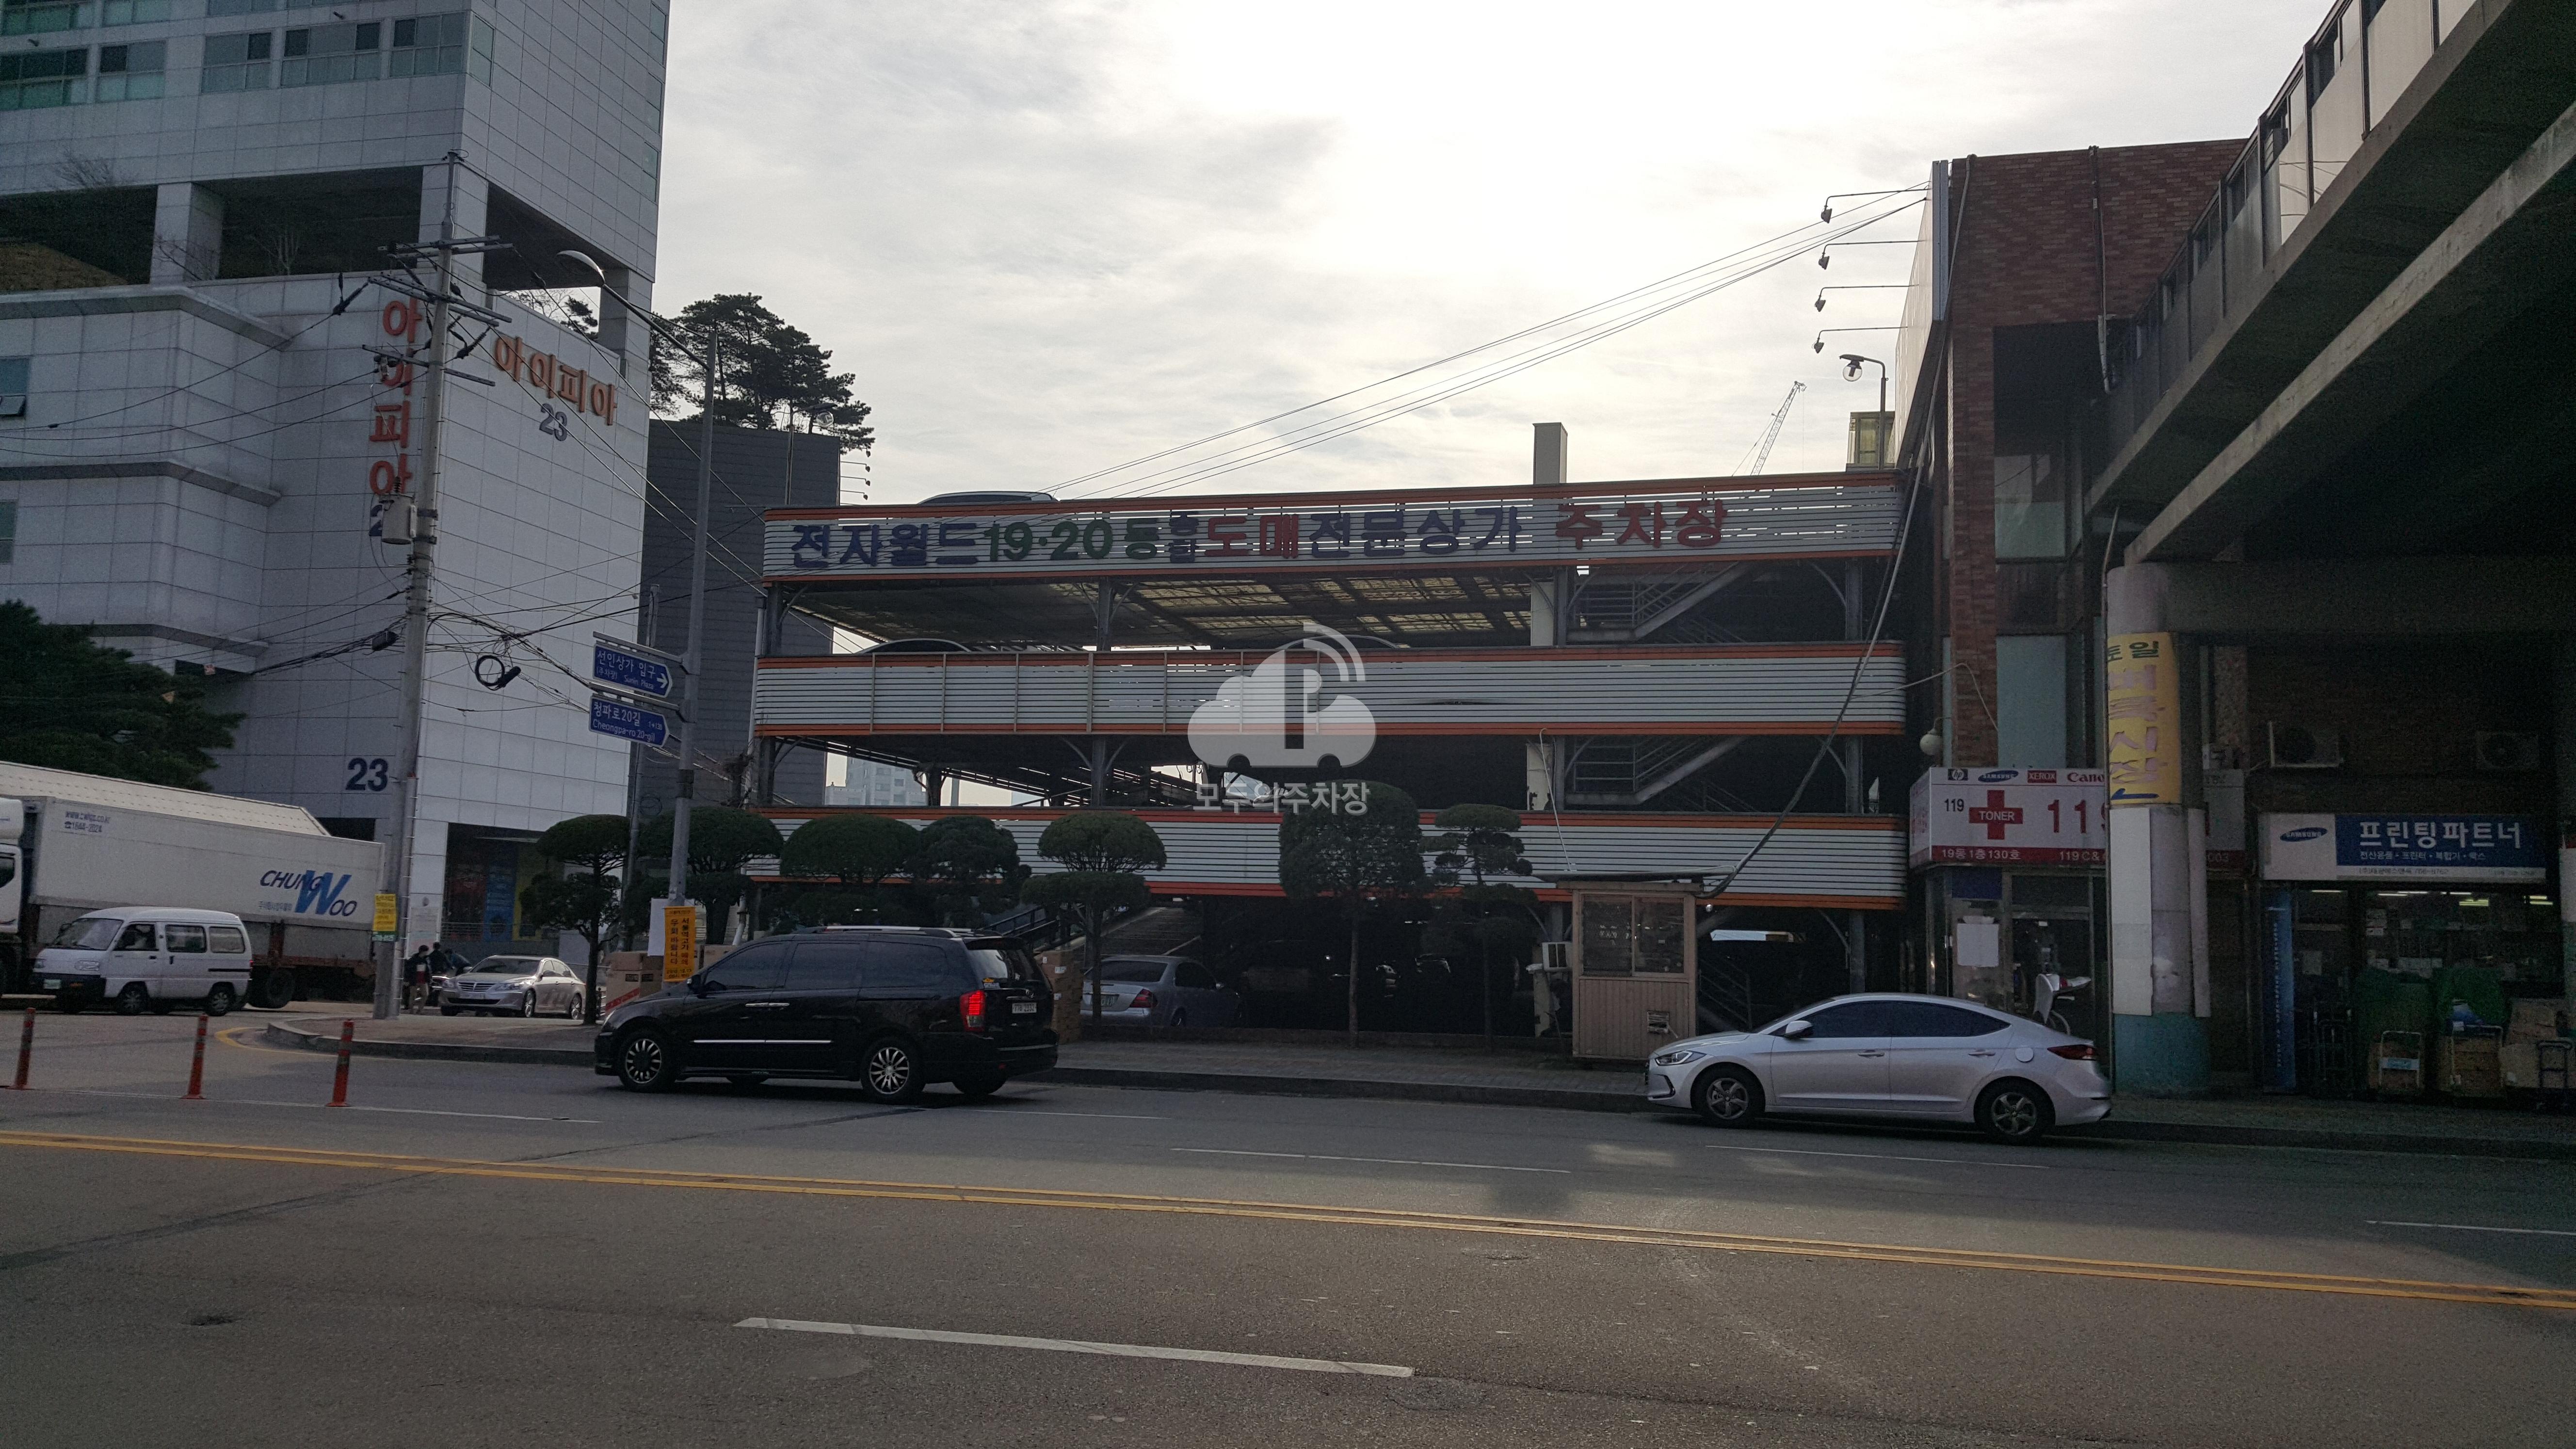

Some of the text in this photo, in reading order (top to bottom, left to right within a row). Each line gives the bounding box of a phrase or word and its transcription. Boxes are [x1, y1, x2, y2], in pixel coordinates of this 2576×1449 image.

[495, 336, 617, 426] 아이피아
[369, 296, 422, 496] 아이피아
[539, 403, 567, 441] 23
[791, 523, 978, 568] 전자월드
[1205, 513, 1298, 559] 도매
[1309, 505, 1522, 559] 전문상가
[1556, 499, 1727, 550] 주차장
[597, 650, 656, 679] 선인상가 입구
[624, 676, 654, 690] Sunin Plaza
[594, 702, 641, 727] 청파로20길
[593, 719, 655, 743] Cheongpa-ro 20-gil
[346, 757, 388, 791] 23
[2029, 772, 2056, 781] XEROX
[2067, 772, 2105, 783] Cano
[1945, 799, 1964, 812] 119
[1979, 810, 2015, 821] TONER
[2285, 831, 2322, 839] SAMSUNG
[2360, 821, 2521, 850] 프린팅파트너
[1942, 849, 2022, 861] 19동 1층 130호
[2402, 851, 2426, 860] 프린터
[260, 869, 325, 891] CHUNG
